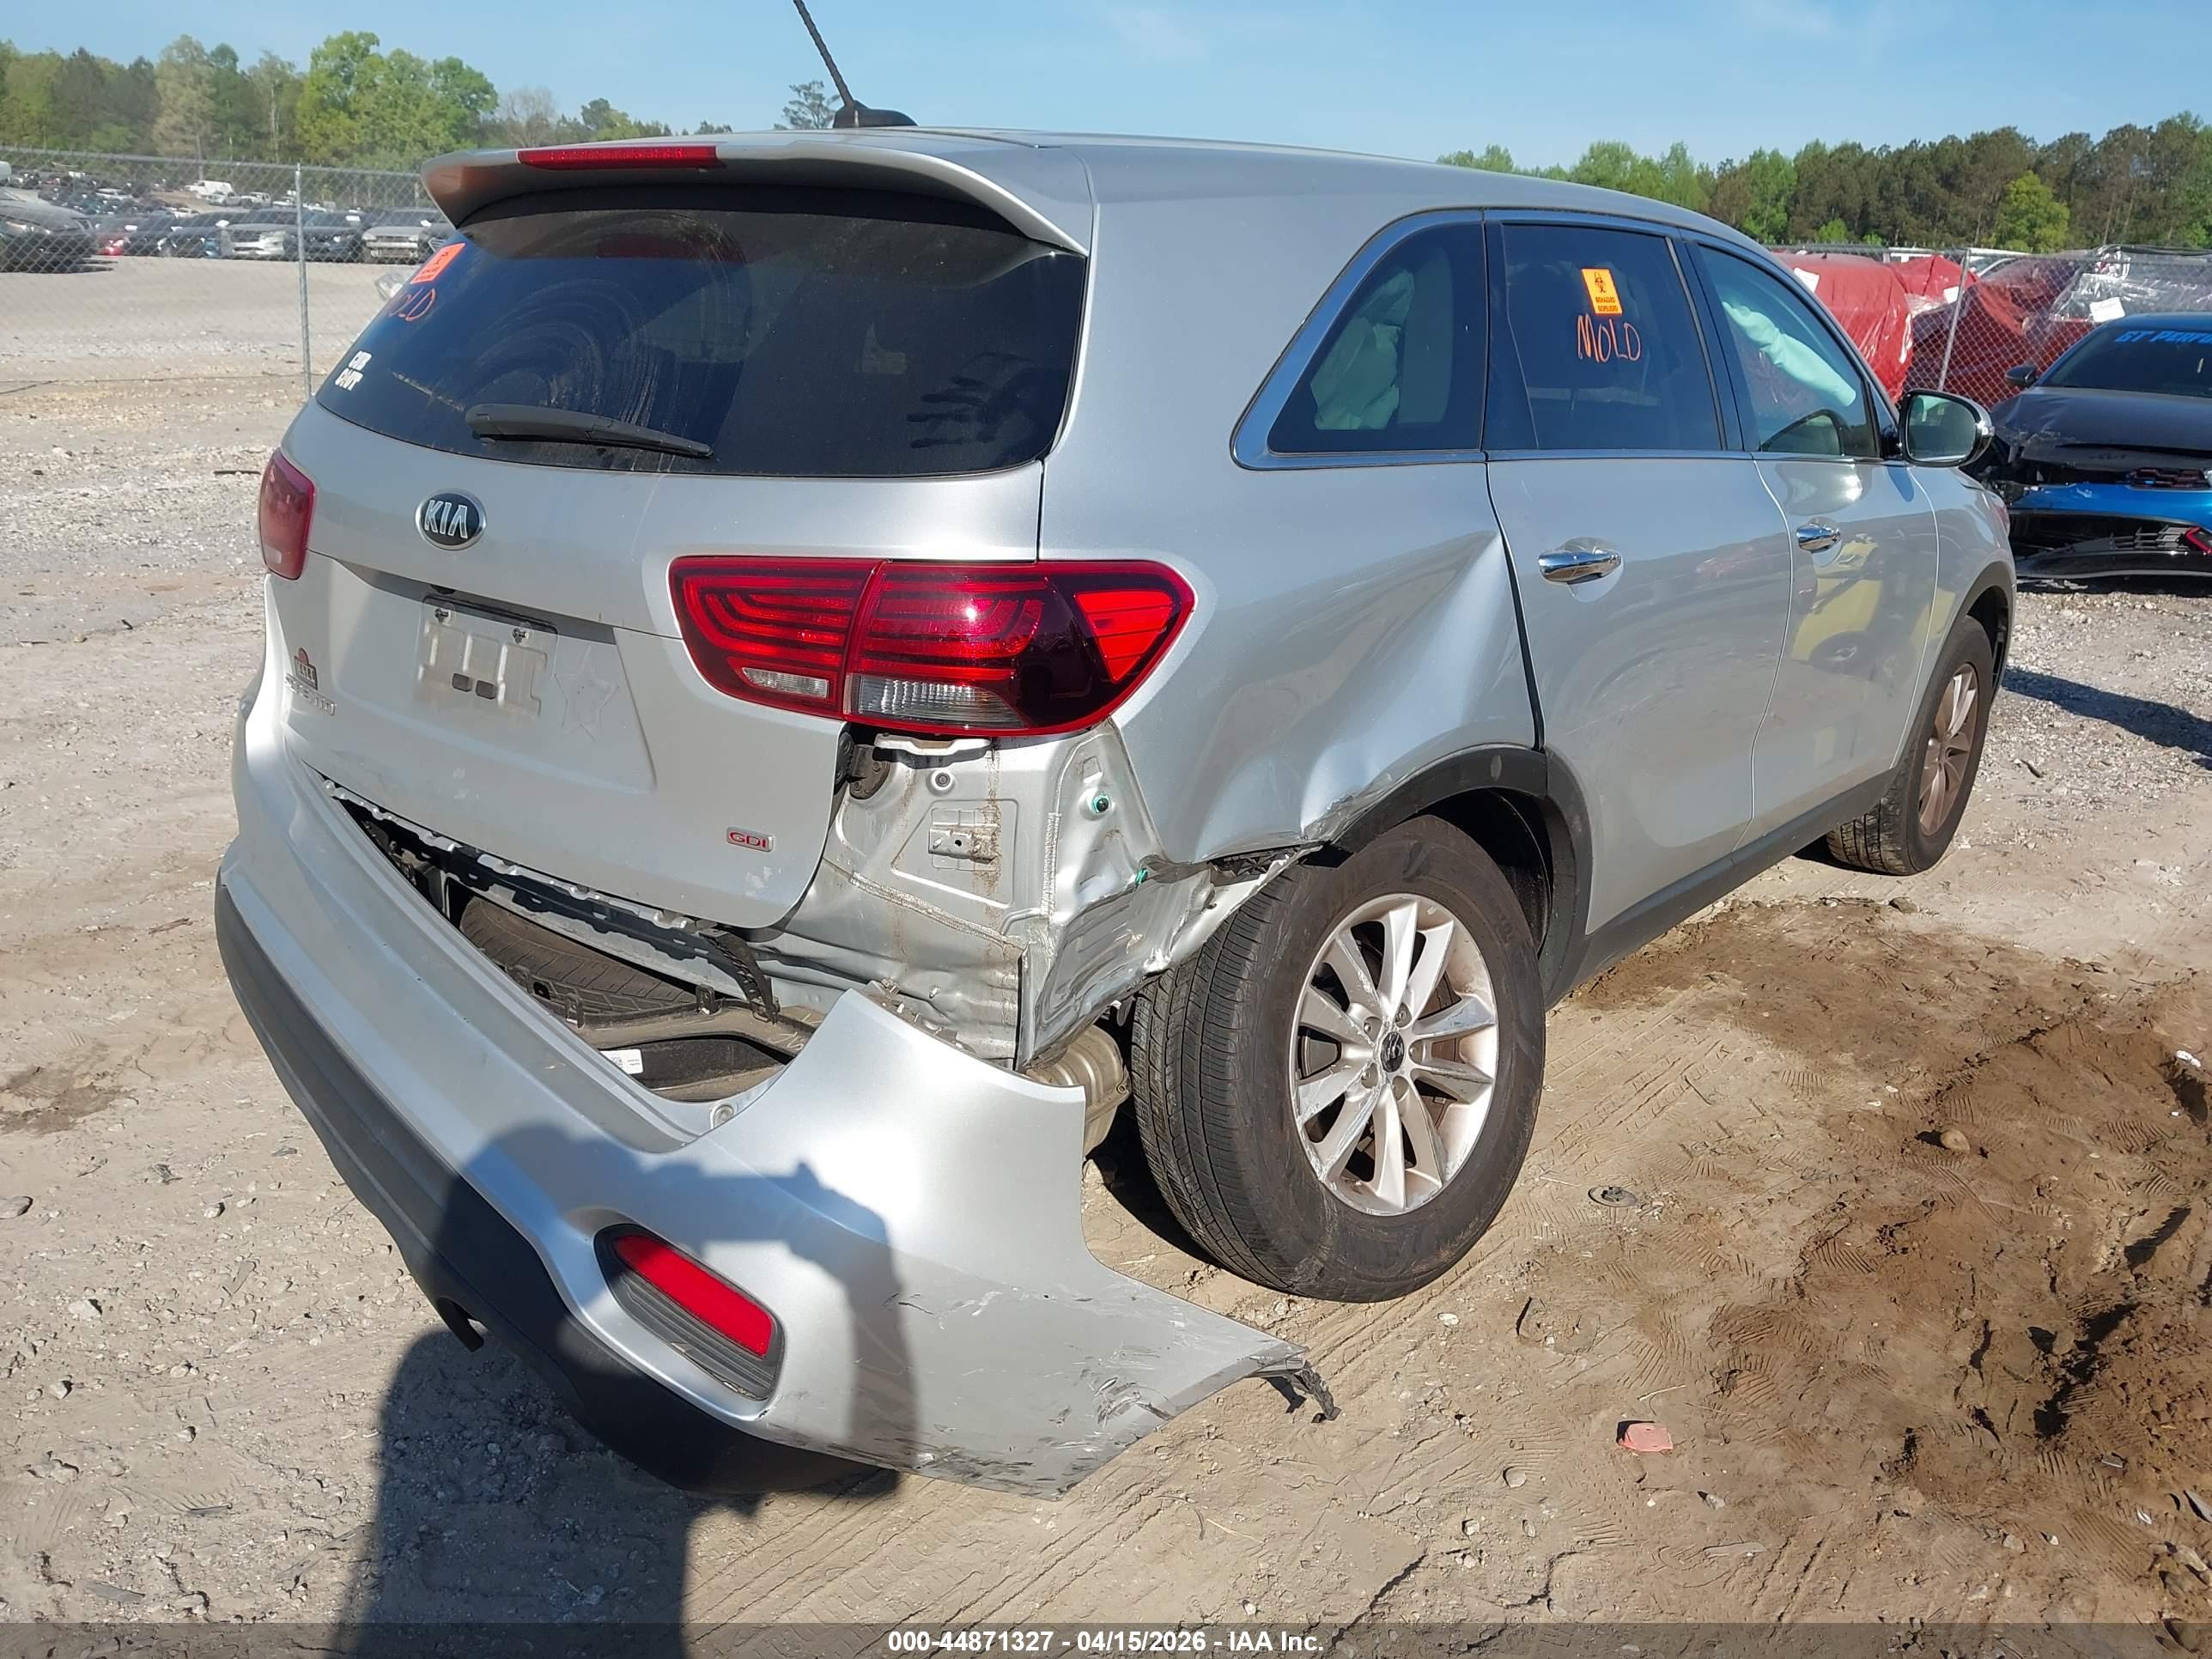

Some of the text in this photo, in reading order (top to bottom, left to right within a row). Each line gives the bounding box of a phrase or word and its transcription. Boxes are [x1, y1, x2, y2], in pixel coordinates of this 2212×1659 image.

[383, 287, 436, 322] OLD
[1577, 313, 1641, 362] MOLD
[424, 500, 468, 538] KIA
[729, 831, 767, 848] GDI
